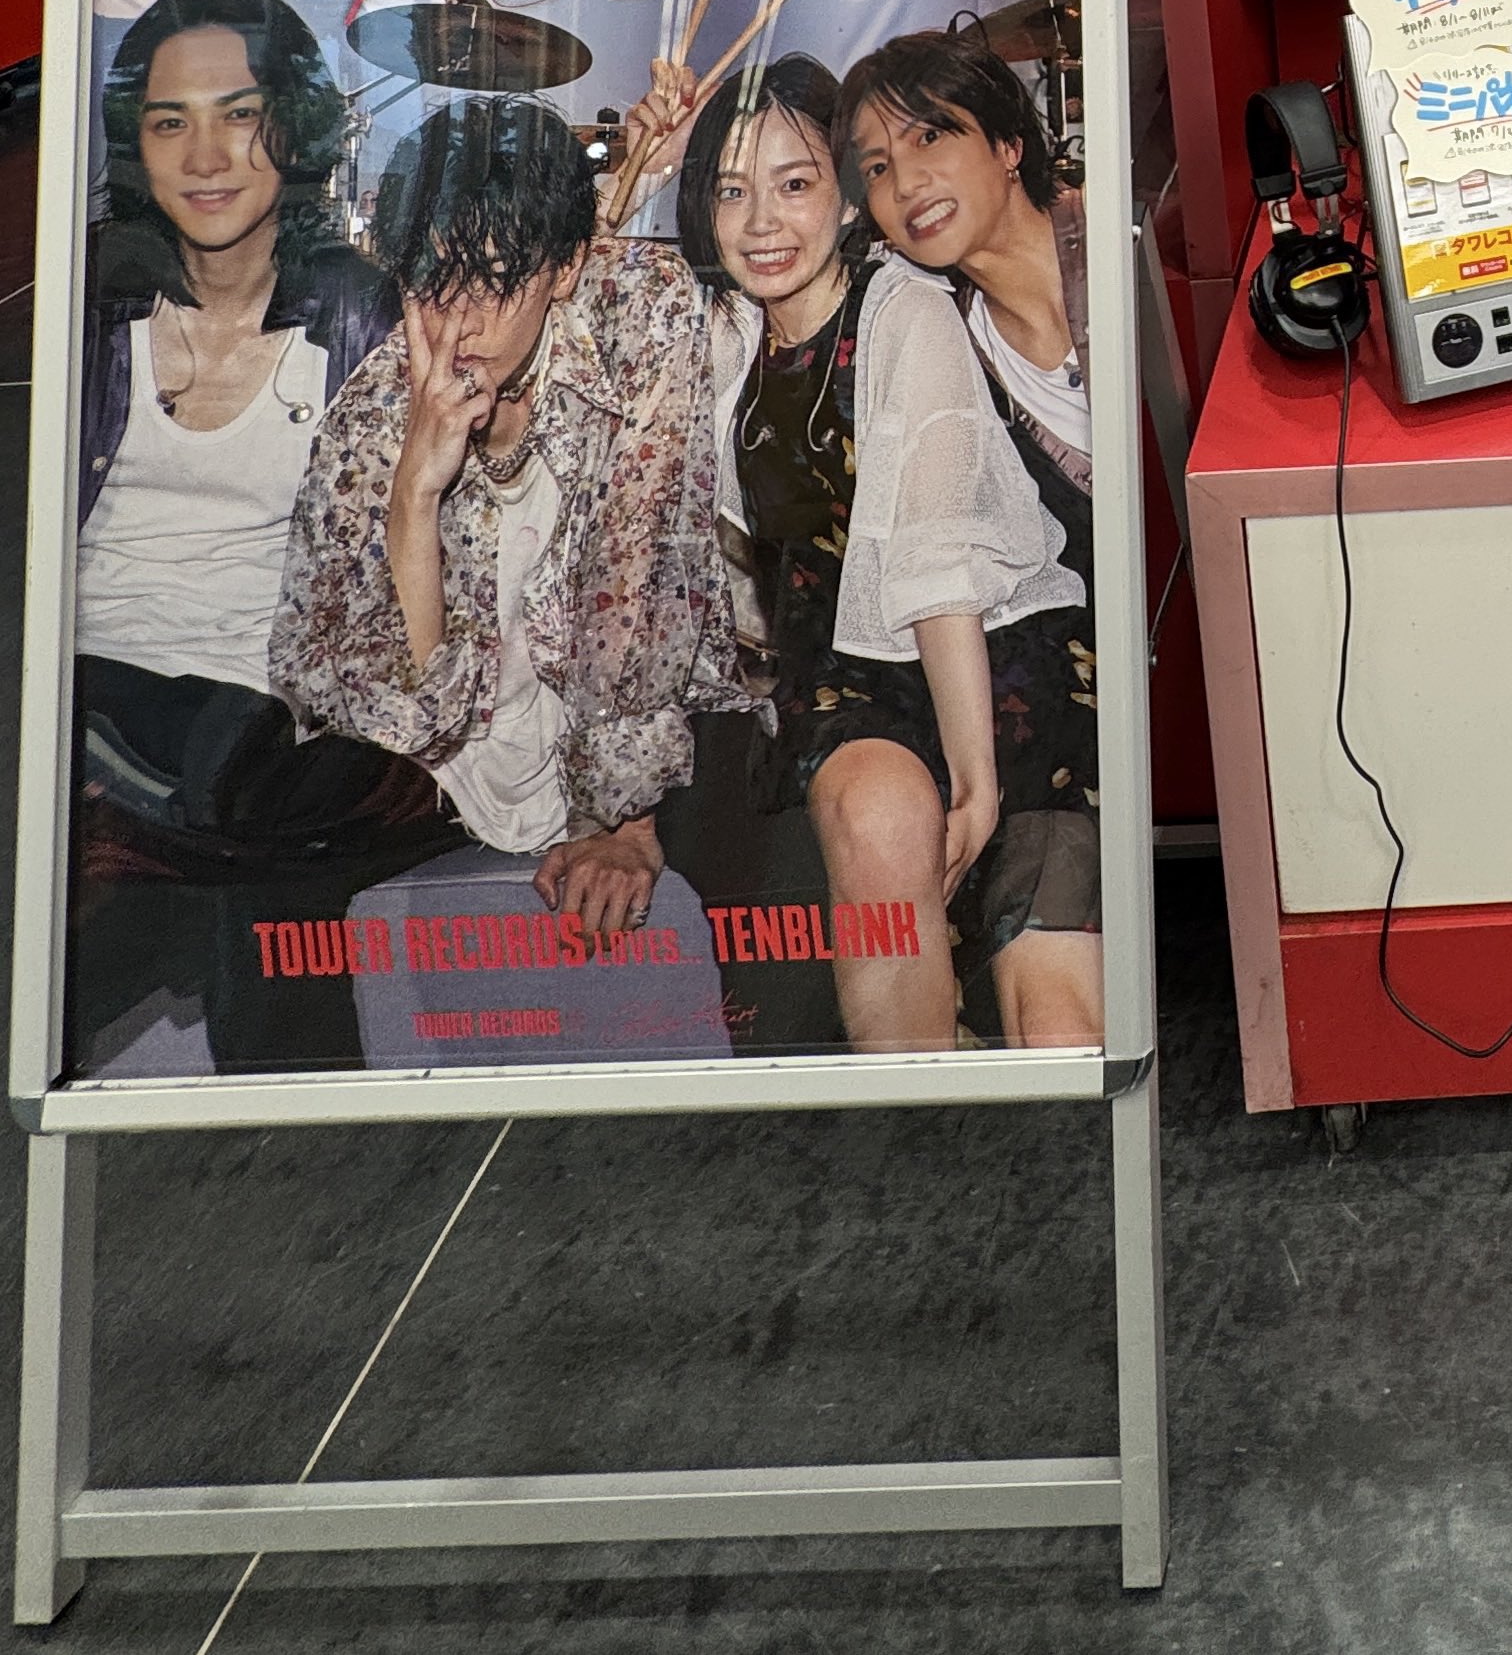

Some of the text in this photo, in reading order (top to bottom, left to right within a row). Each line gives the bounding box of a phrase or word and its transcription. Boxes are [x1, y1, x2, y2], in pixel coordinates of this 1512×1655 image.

[253, 917, 393, 978] TOWER
[406, 912, 588, 975] RECORDS
[709, 901, 921, 964] TENBLANK
[411, 1007, 560, 1039] TOWER RECORDS
